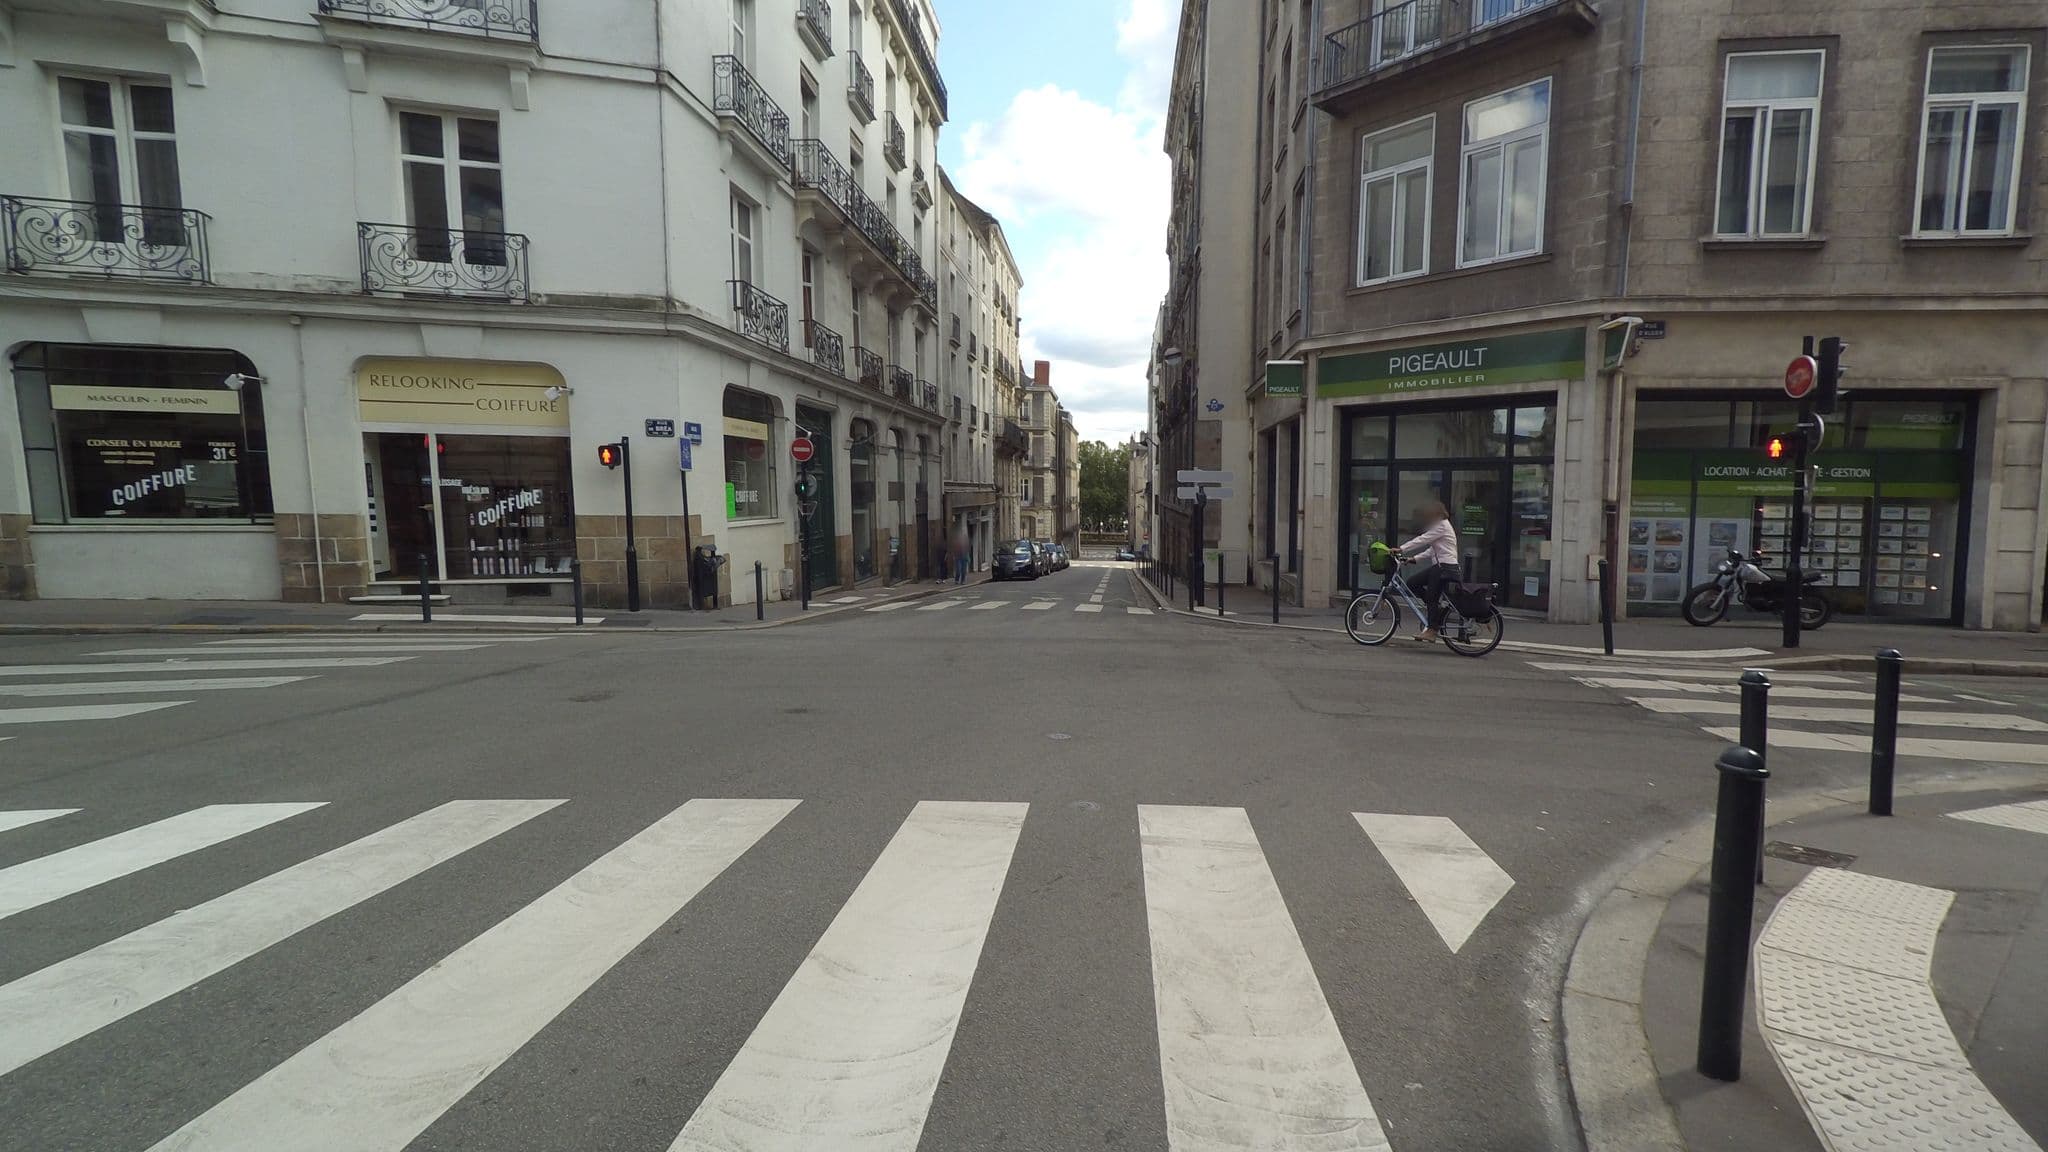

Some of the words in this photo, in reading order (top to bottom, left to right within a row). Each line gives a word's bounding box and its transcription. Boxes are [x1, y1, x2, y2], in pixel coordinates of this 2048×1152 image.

[1388, 347, 1488, 374] PIGEAULT
[369, 374, 475, 390] RELOOKING
[1388, 374, 1486, 389] IMMOBILIER
[87, 394, 150, 404] MASCULIN
[161, 396, 208, 405] FEMININ
[476, 398, 559, 413] COIFFURE
[86, 439, 130, 447] CONSEIL
[132, 439, 146, 447] EN
[149, 440, 183, 448] IMAGE
[212, 447, 226, 460] 31
[1704, 466, 1750, 477] LOCATION
[1756, 466, 1787, 477] ACHAT
[1830, 467, 1871, 478] GESTION
[112, 464, 197, 506] COIFFURE
[477, 488, 543, 526] COIFFURE
